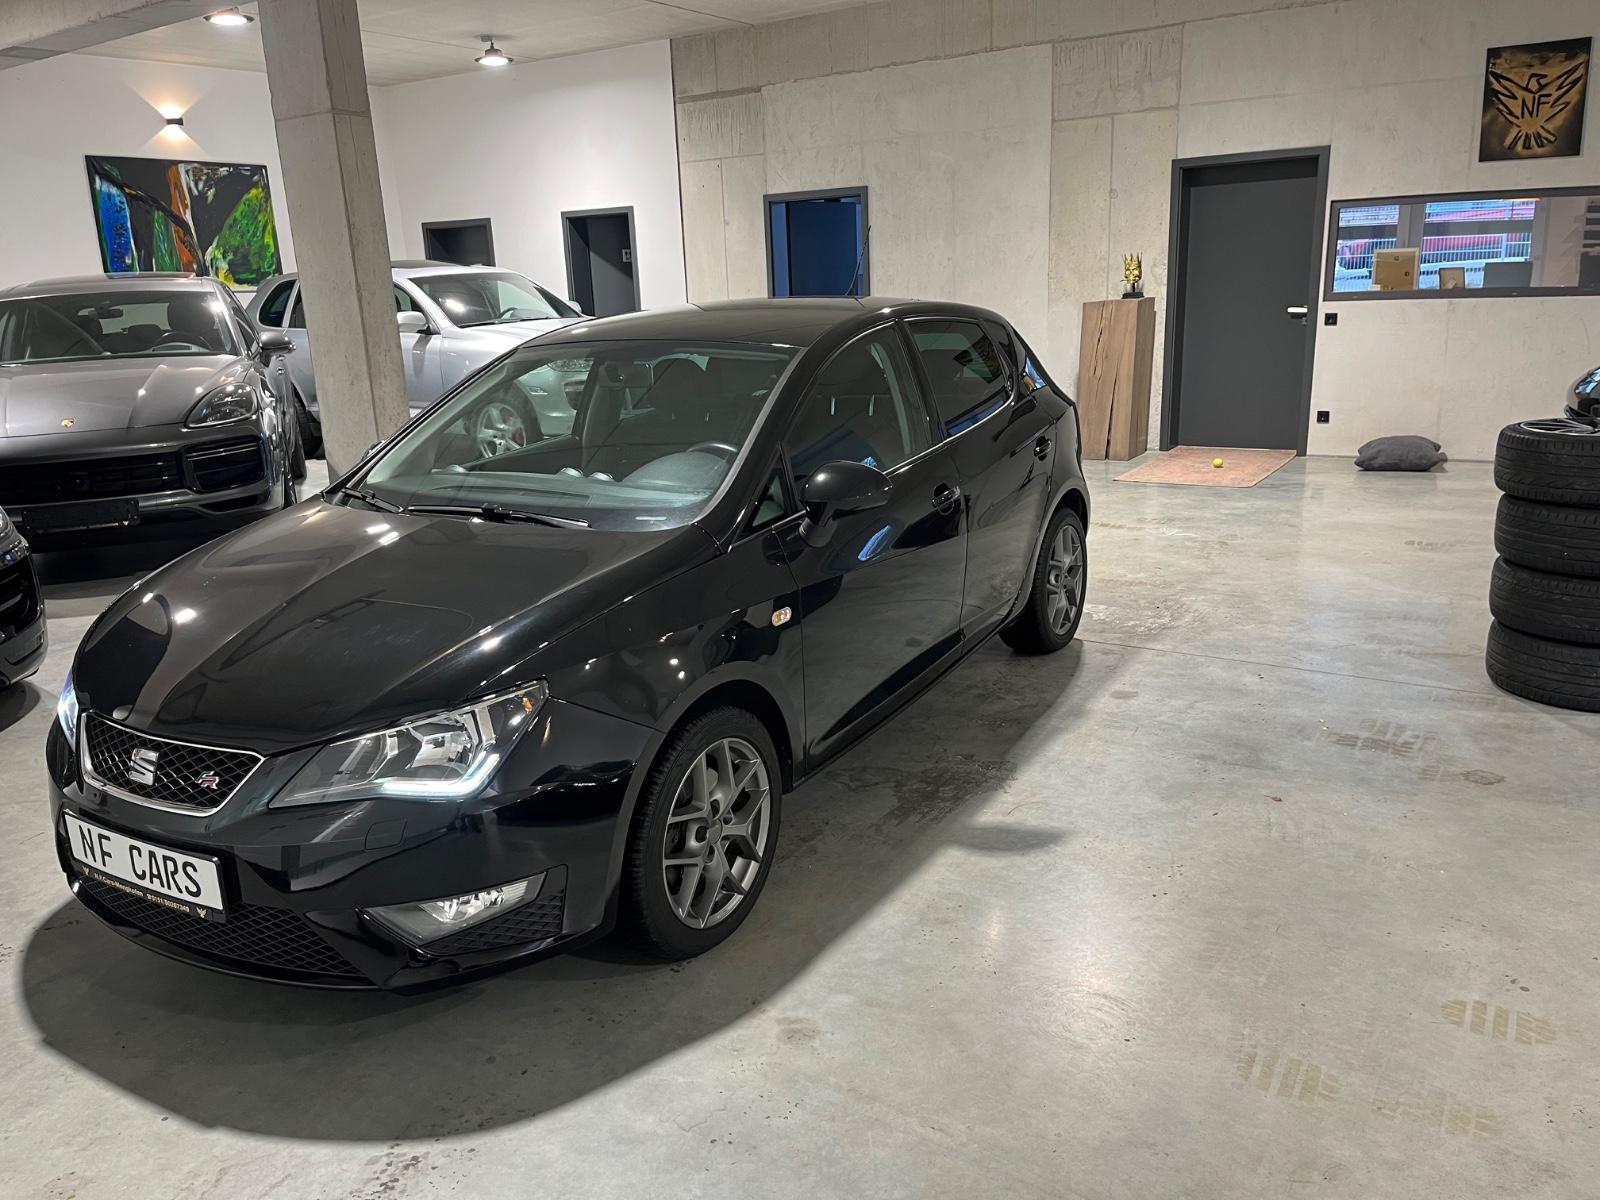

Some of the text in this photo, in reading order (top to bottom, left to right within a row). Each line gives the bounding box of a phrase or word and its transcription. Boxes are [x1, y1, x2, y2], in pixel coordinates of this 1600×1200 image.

[1521, 94, 1553, 119] NF
[78, 824, 202, 898] NF CARS
